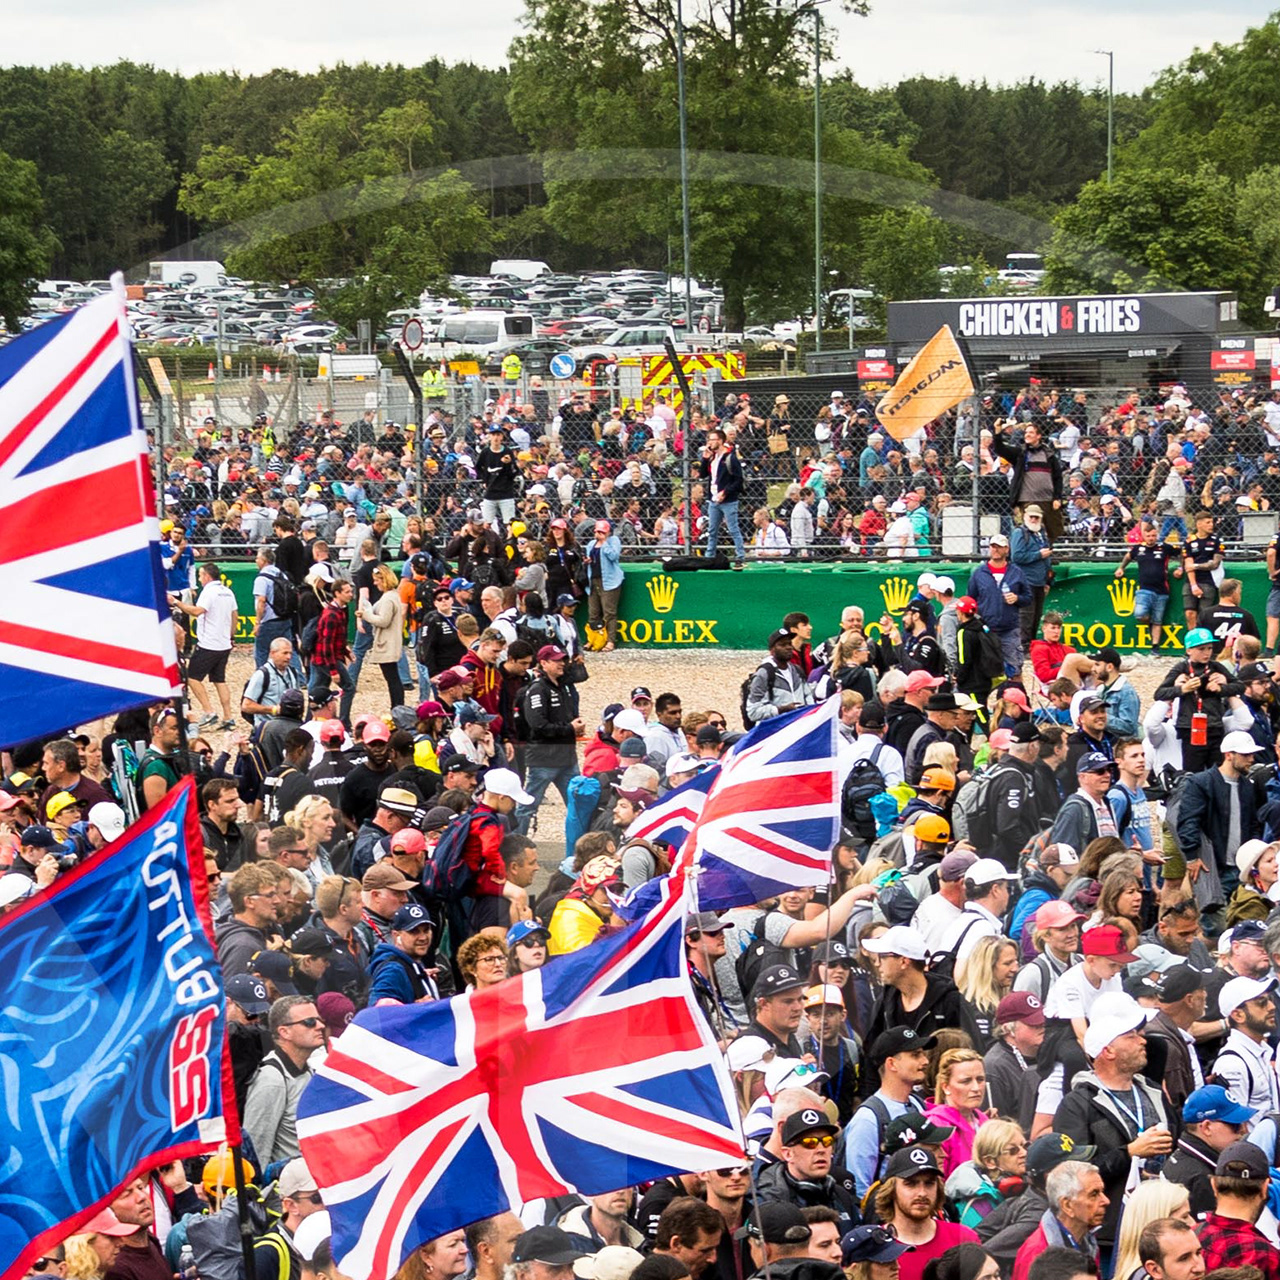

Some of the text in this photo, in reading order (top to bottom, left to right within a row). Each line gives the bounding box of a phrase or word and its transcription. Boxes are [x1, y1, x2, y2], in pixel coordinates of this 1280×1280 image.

[959, 299, 1141, 337] CHICKEN & FRIES
[616, 619, 720, 643] ROLEX
[1062, 623, 1184, 649] ROLEX
[1214, 622, 1241, 639] 44
[898, 1127, 917, 1144] 14
